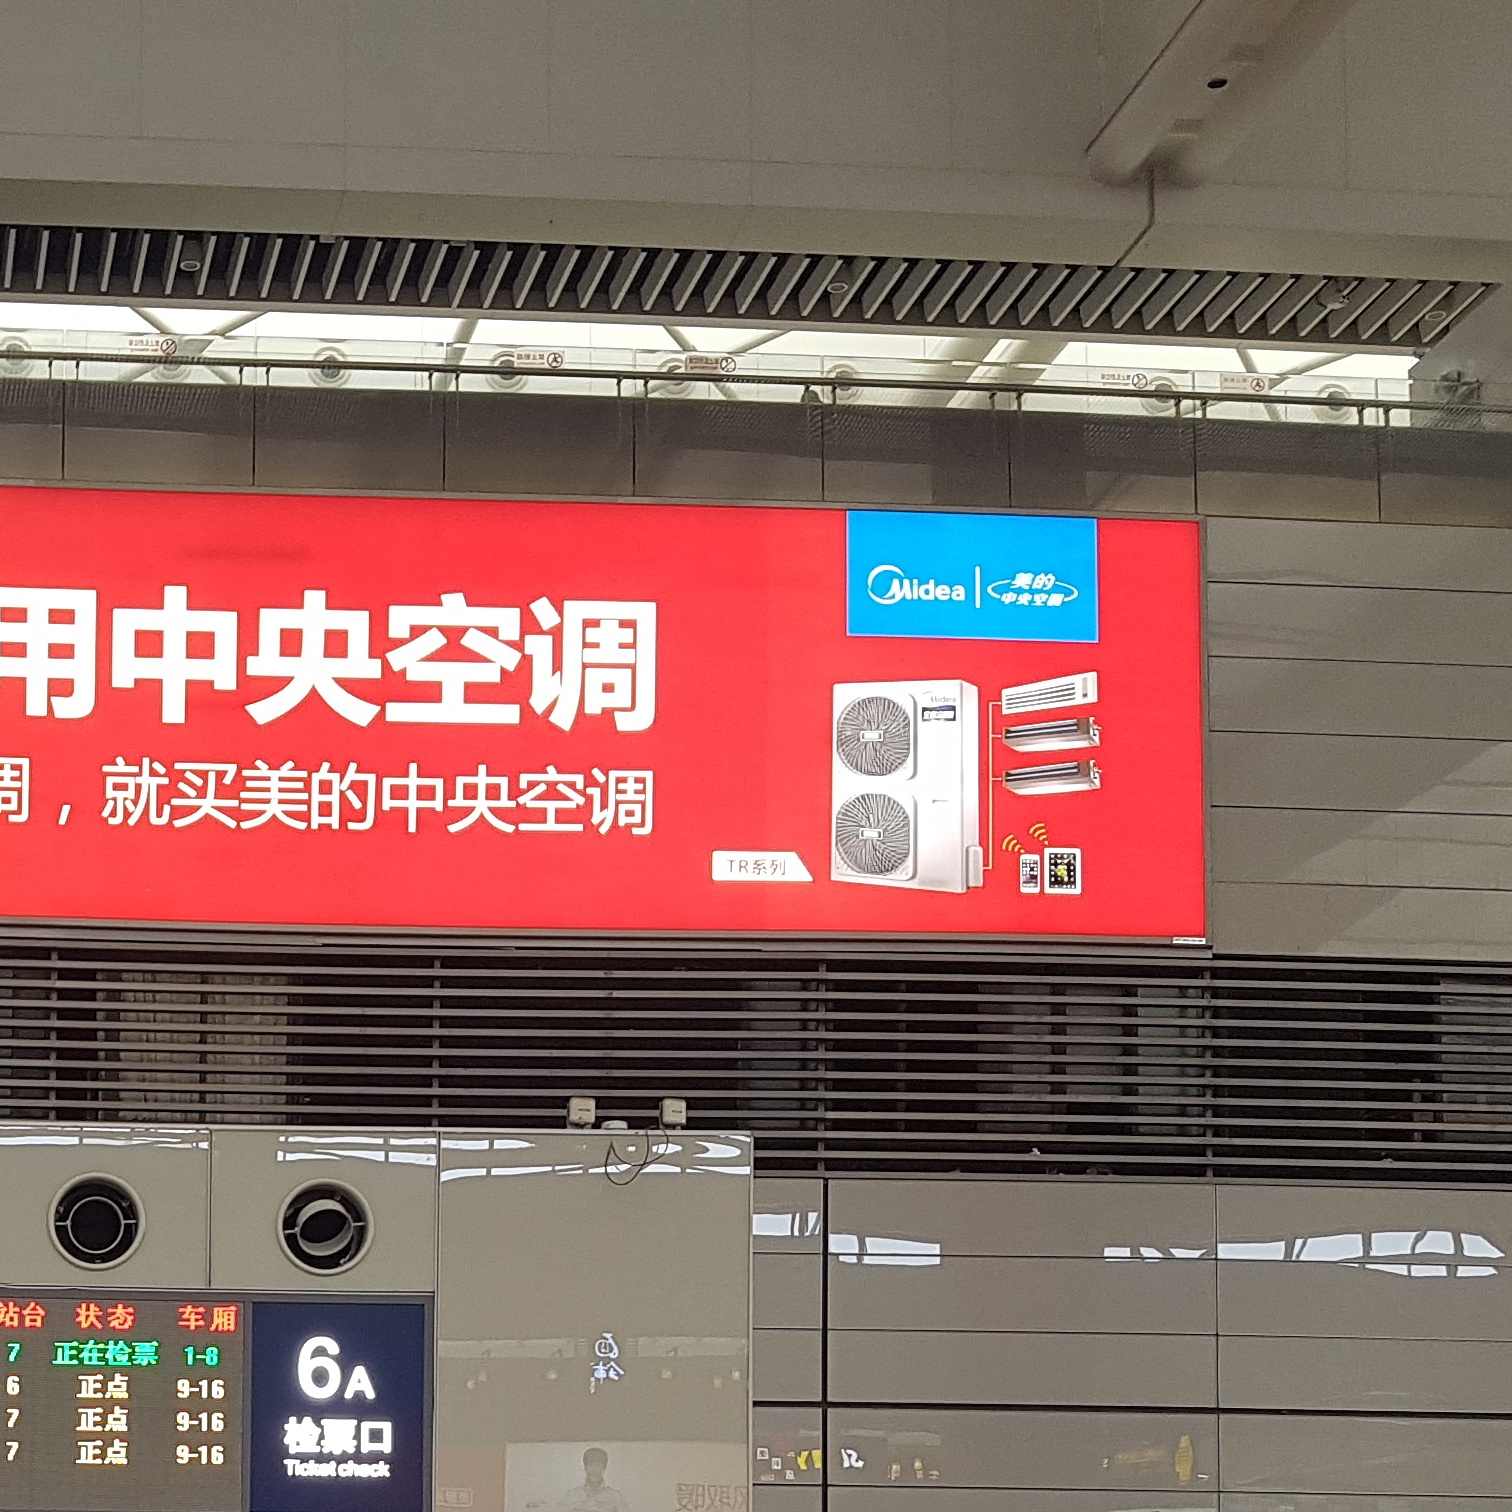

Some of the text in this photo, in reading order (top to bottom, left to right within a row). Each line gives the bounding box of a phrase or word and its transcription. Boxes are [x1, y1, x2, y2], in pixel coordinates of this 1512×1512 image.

[871, 569, 965, 603] Midea
[1010, 572, 1056, 590] 美的
[75, 1303, 135, 1330] 状态
[178, 1306, 237, 1331] 车厢
[7, 1343, 20, 1361] 7
[51, 1340, 159, 1366] 正在检票
[184, 1347, 219, 1366] 1-8
[6, 1376, 20, 1395] 6
[76, 1373, 129, 1399] 正点
[176, 1379, 225, 1399] 9-16
[6, 1409, 19, 1428] 7
[76, 1406, 129, 1431] 正点
[176, 1412, 225, 1431] 9-16
[283, 1416, 392, 1454] 检票口
[6, 1442, 19, 1460] 7
[76, 1439, 129, 1464] 正点
[176, 1445, 225, 1464] 9-16
[283, 1459, 390, 1477] Ticket check
